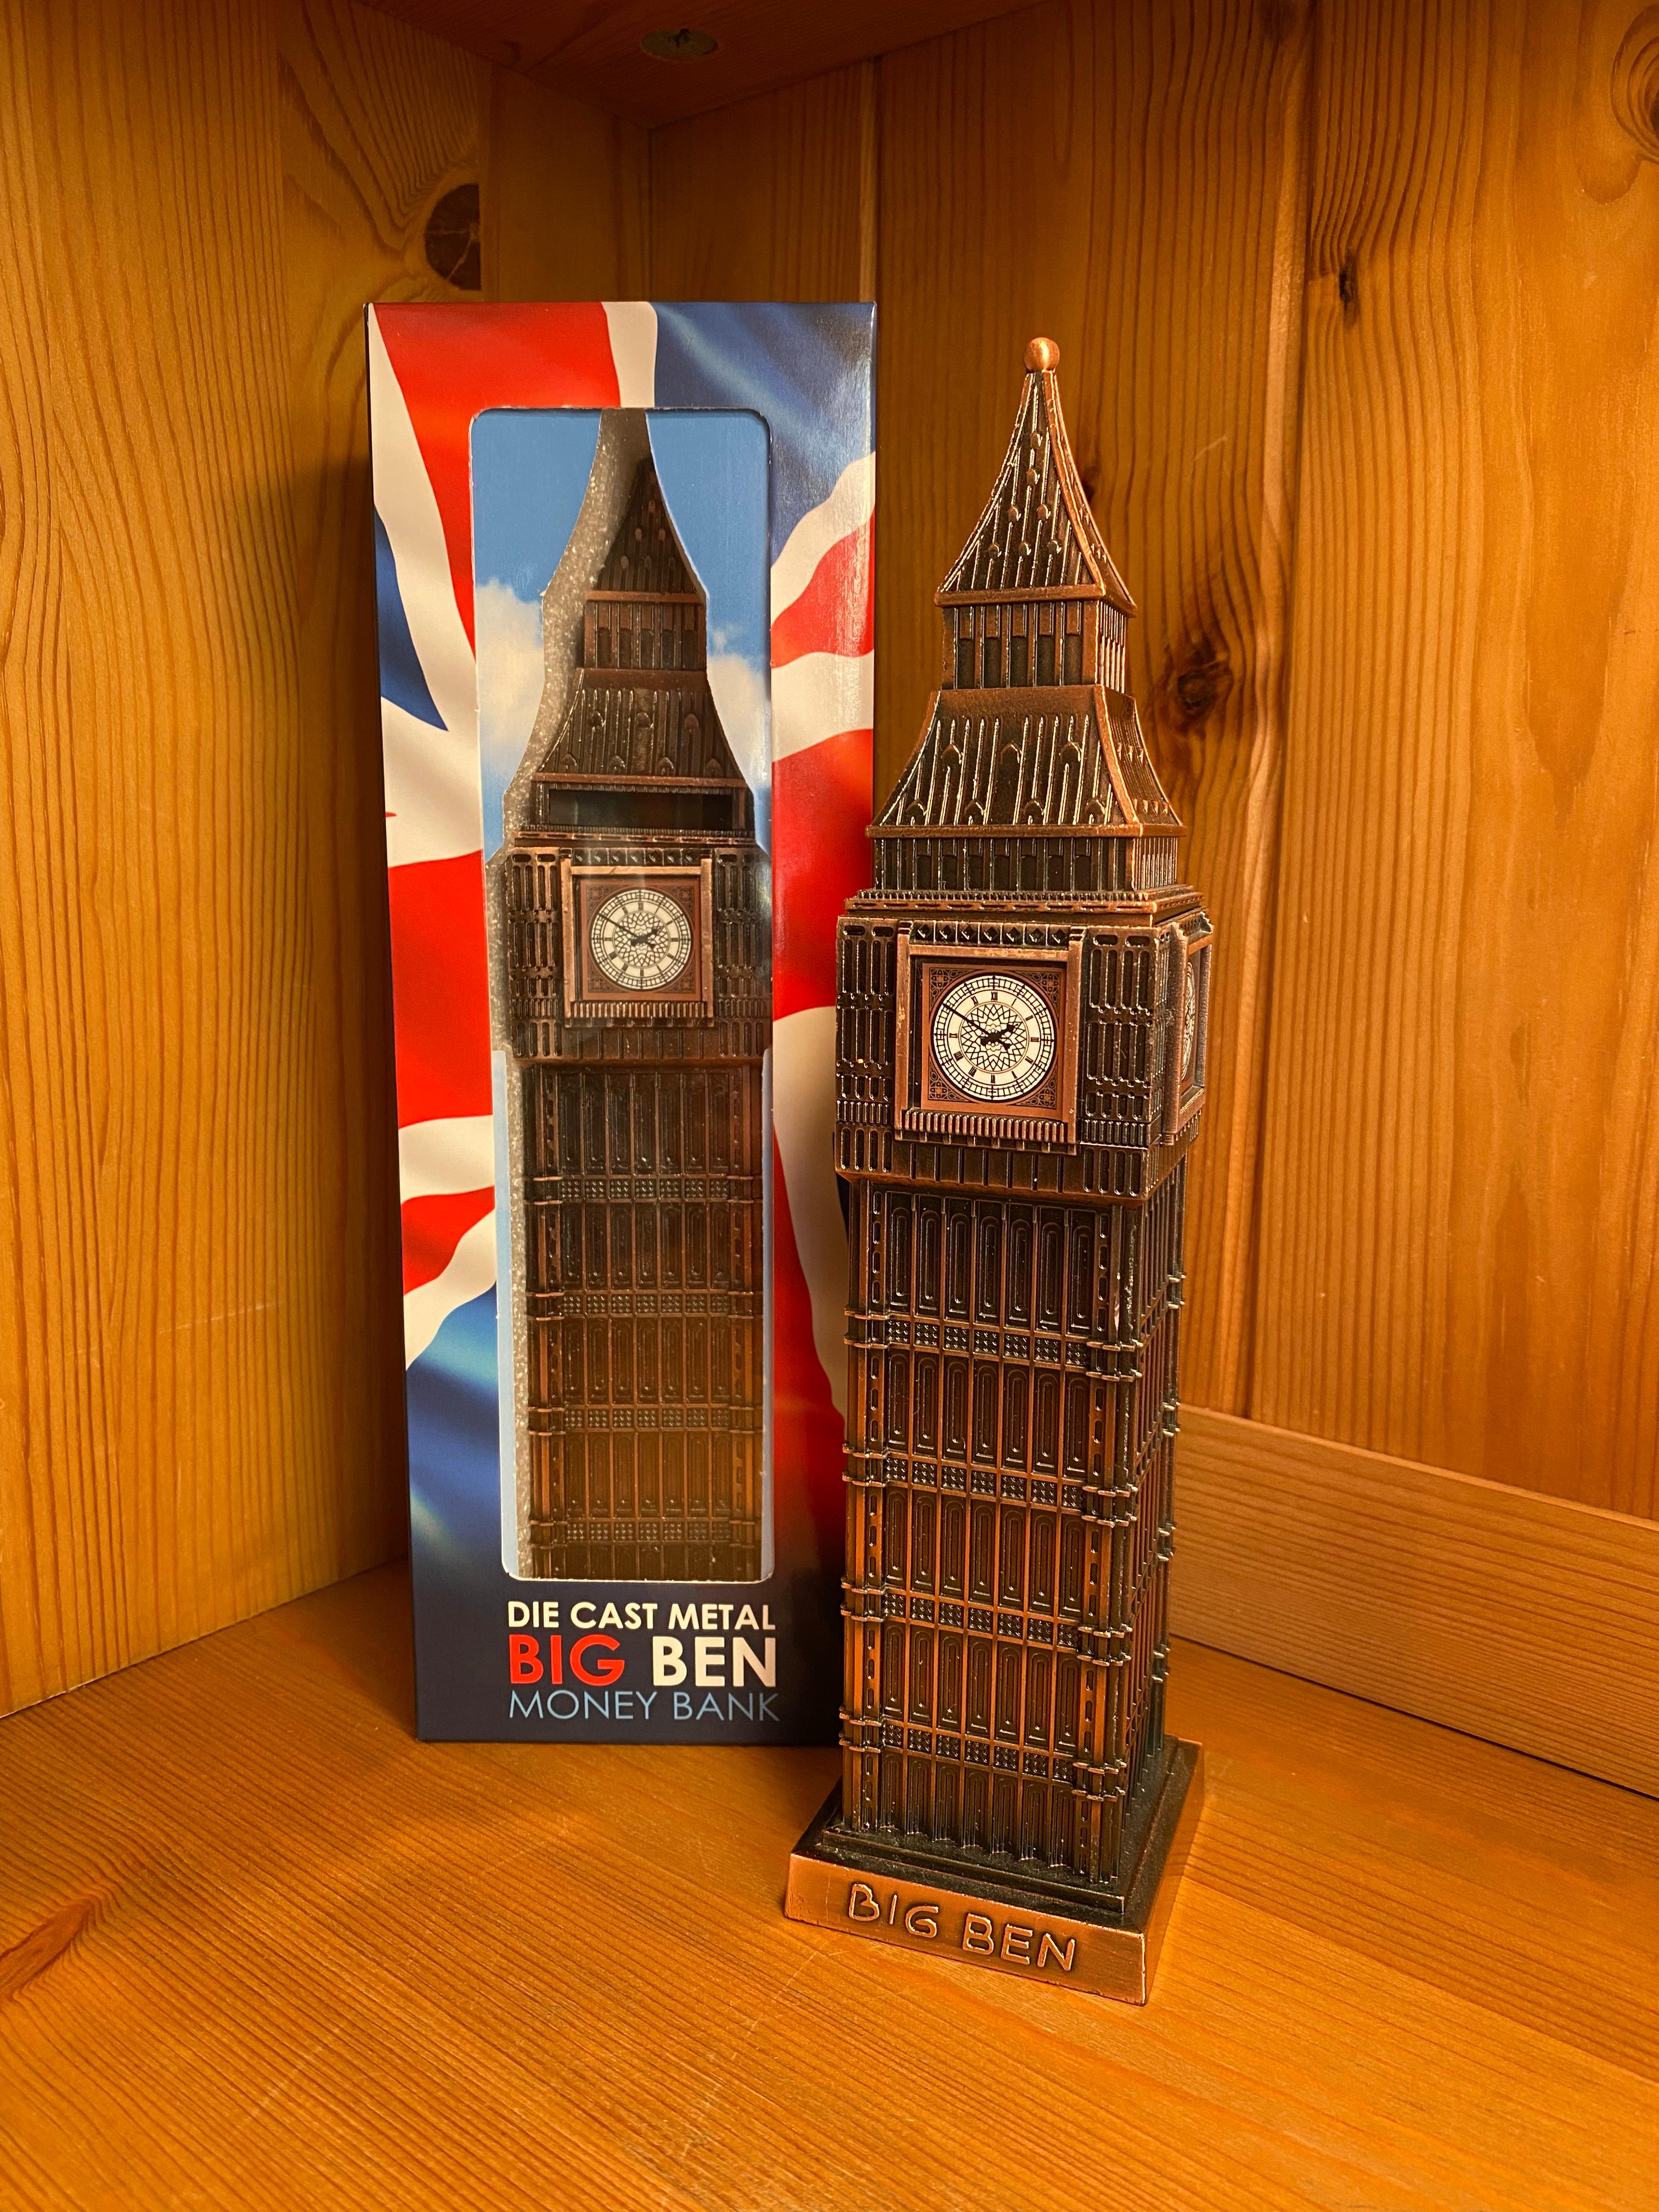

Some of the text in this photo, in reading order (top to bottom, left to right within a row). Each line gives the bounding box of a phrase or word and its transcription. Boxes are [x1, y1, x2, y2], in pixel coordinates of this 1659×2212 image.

[507, 1601, 776, 1630] DIE CAST METAL
[509, 1634, 776, 1687] BIG BEN
[509, 1690, 780, 1722] MONEY BANK
[848, 1883, 1076, 1971] BIG BEN
